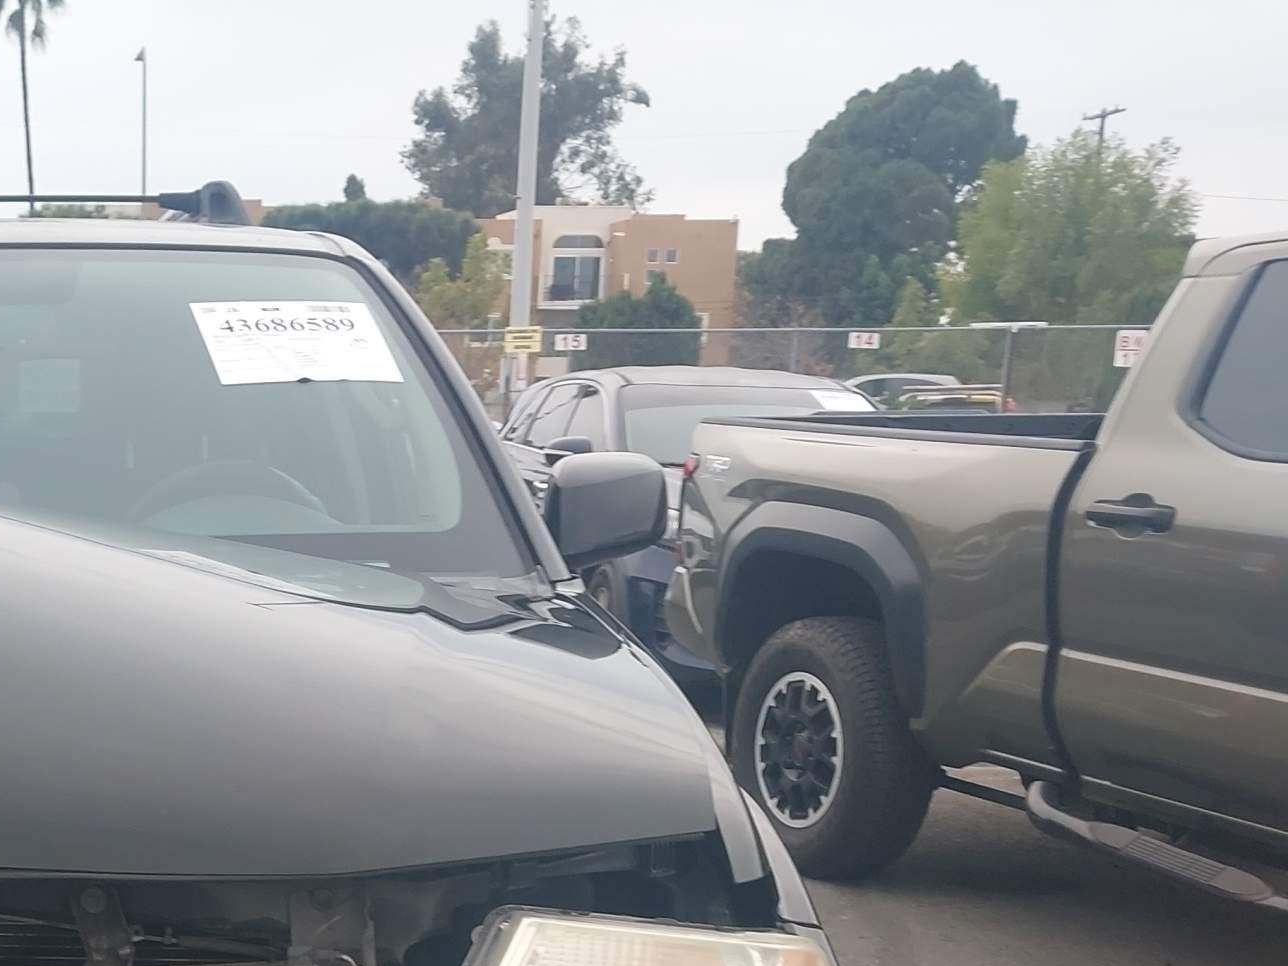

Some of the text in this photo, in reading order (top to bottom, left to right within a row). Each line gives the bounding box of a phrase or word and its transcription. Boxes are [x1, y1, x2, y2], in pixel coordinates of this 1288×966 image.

[219, 317, 355, 333] 43686589
[560, 334, 582, 349] 15
[855, 334, 874, 348] 14
